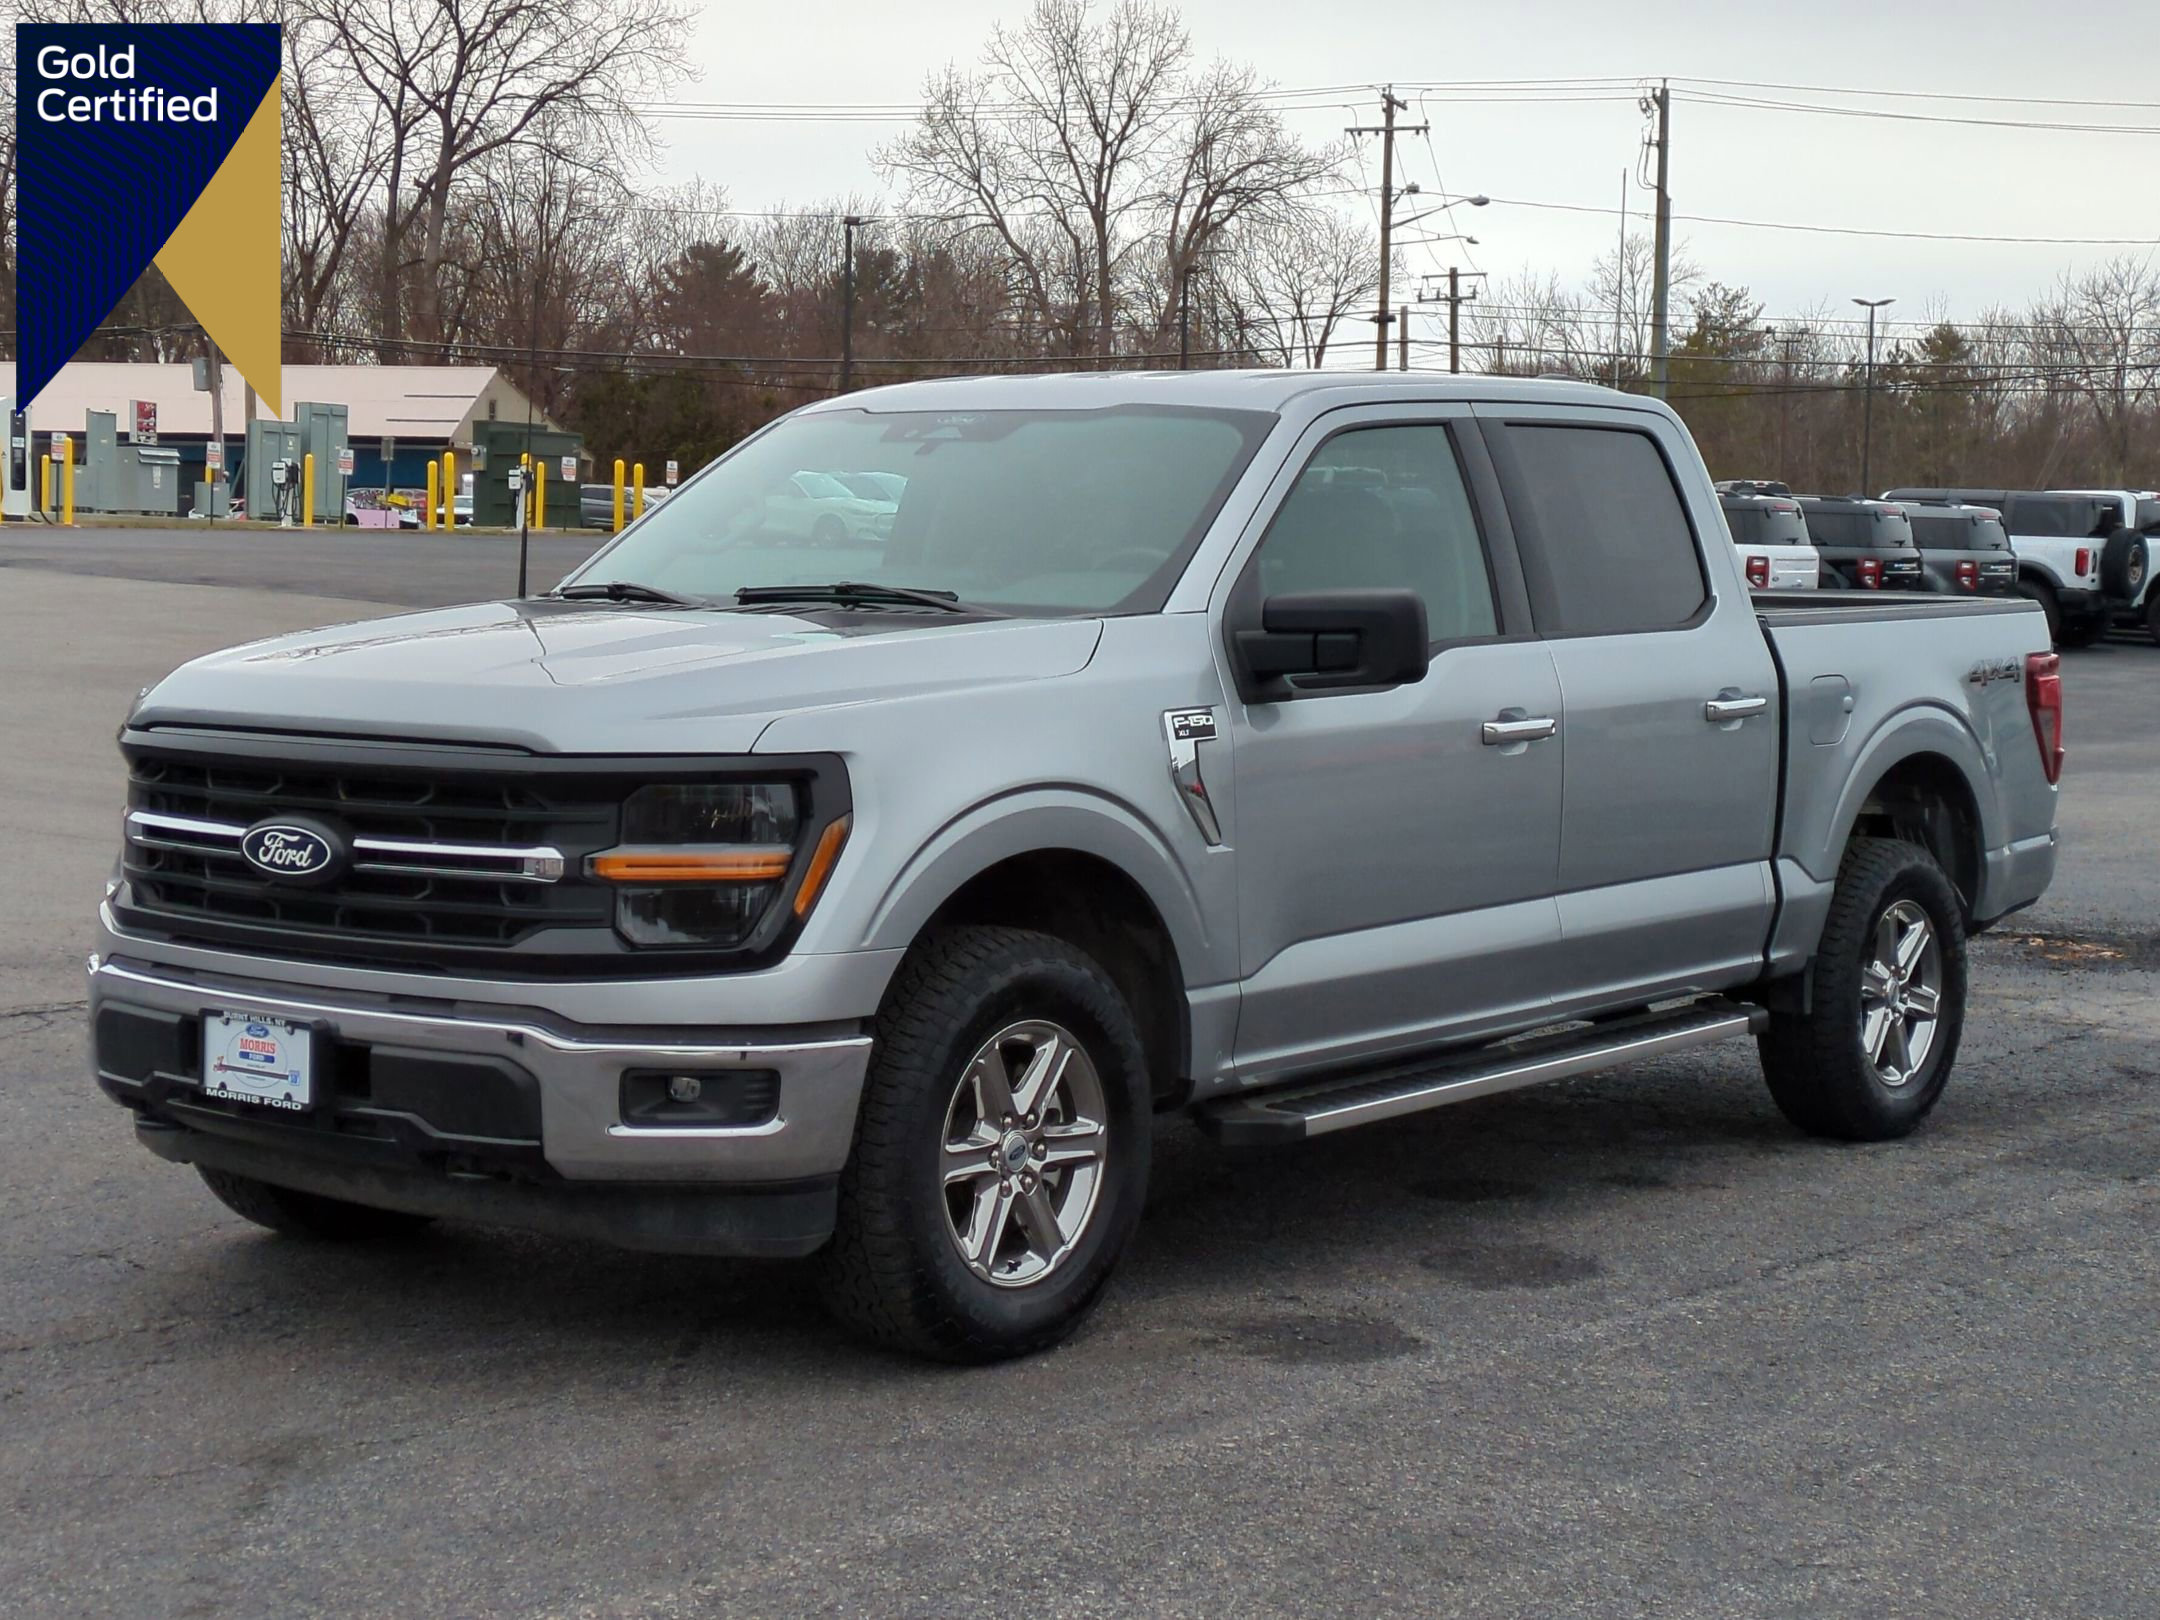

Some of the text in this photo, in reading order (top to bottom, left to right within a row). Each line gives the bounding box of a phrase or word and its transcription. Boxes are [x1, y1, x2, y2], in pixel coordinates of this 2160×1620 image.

[1173, 715, 1214, 728] F-150
[258, 831, 314, 867] Ford
[240, 1037, 276, 1055] MORRIS
[206, 1087, 302, 1111] MORRIS FORD
